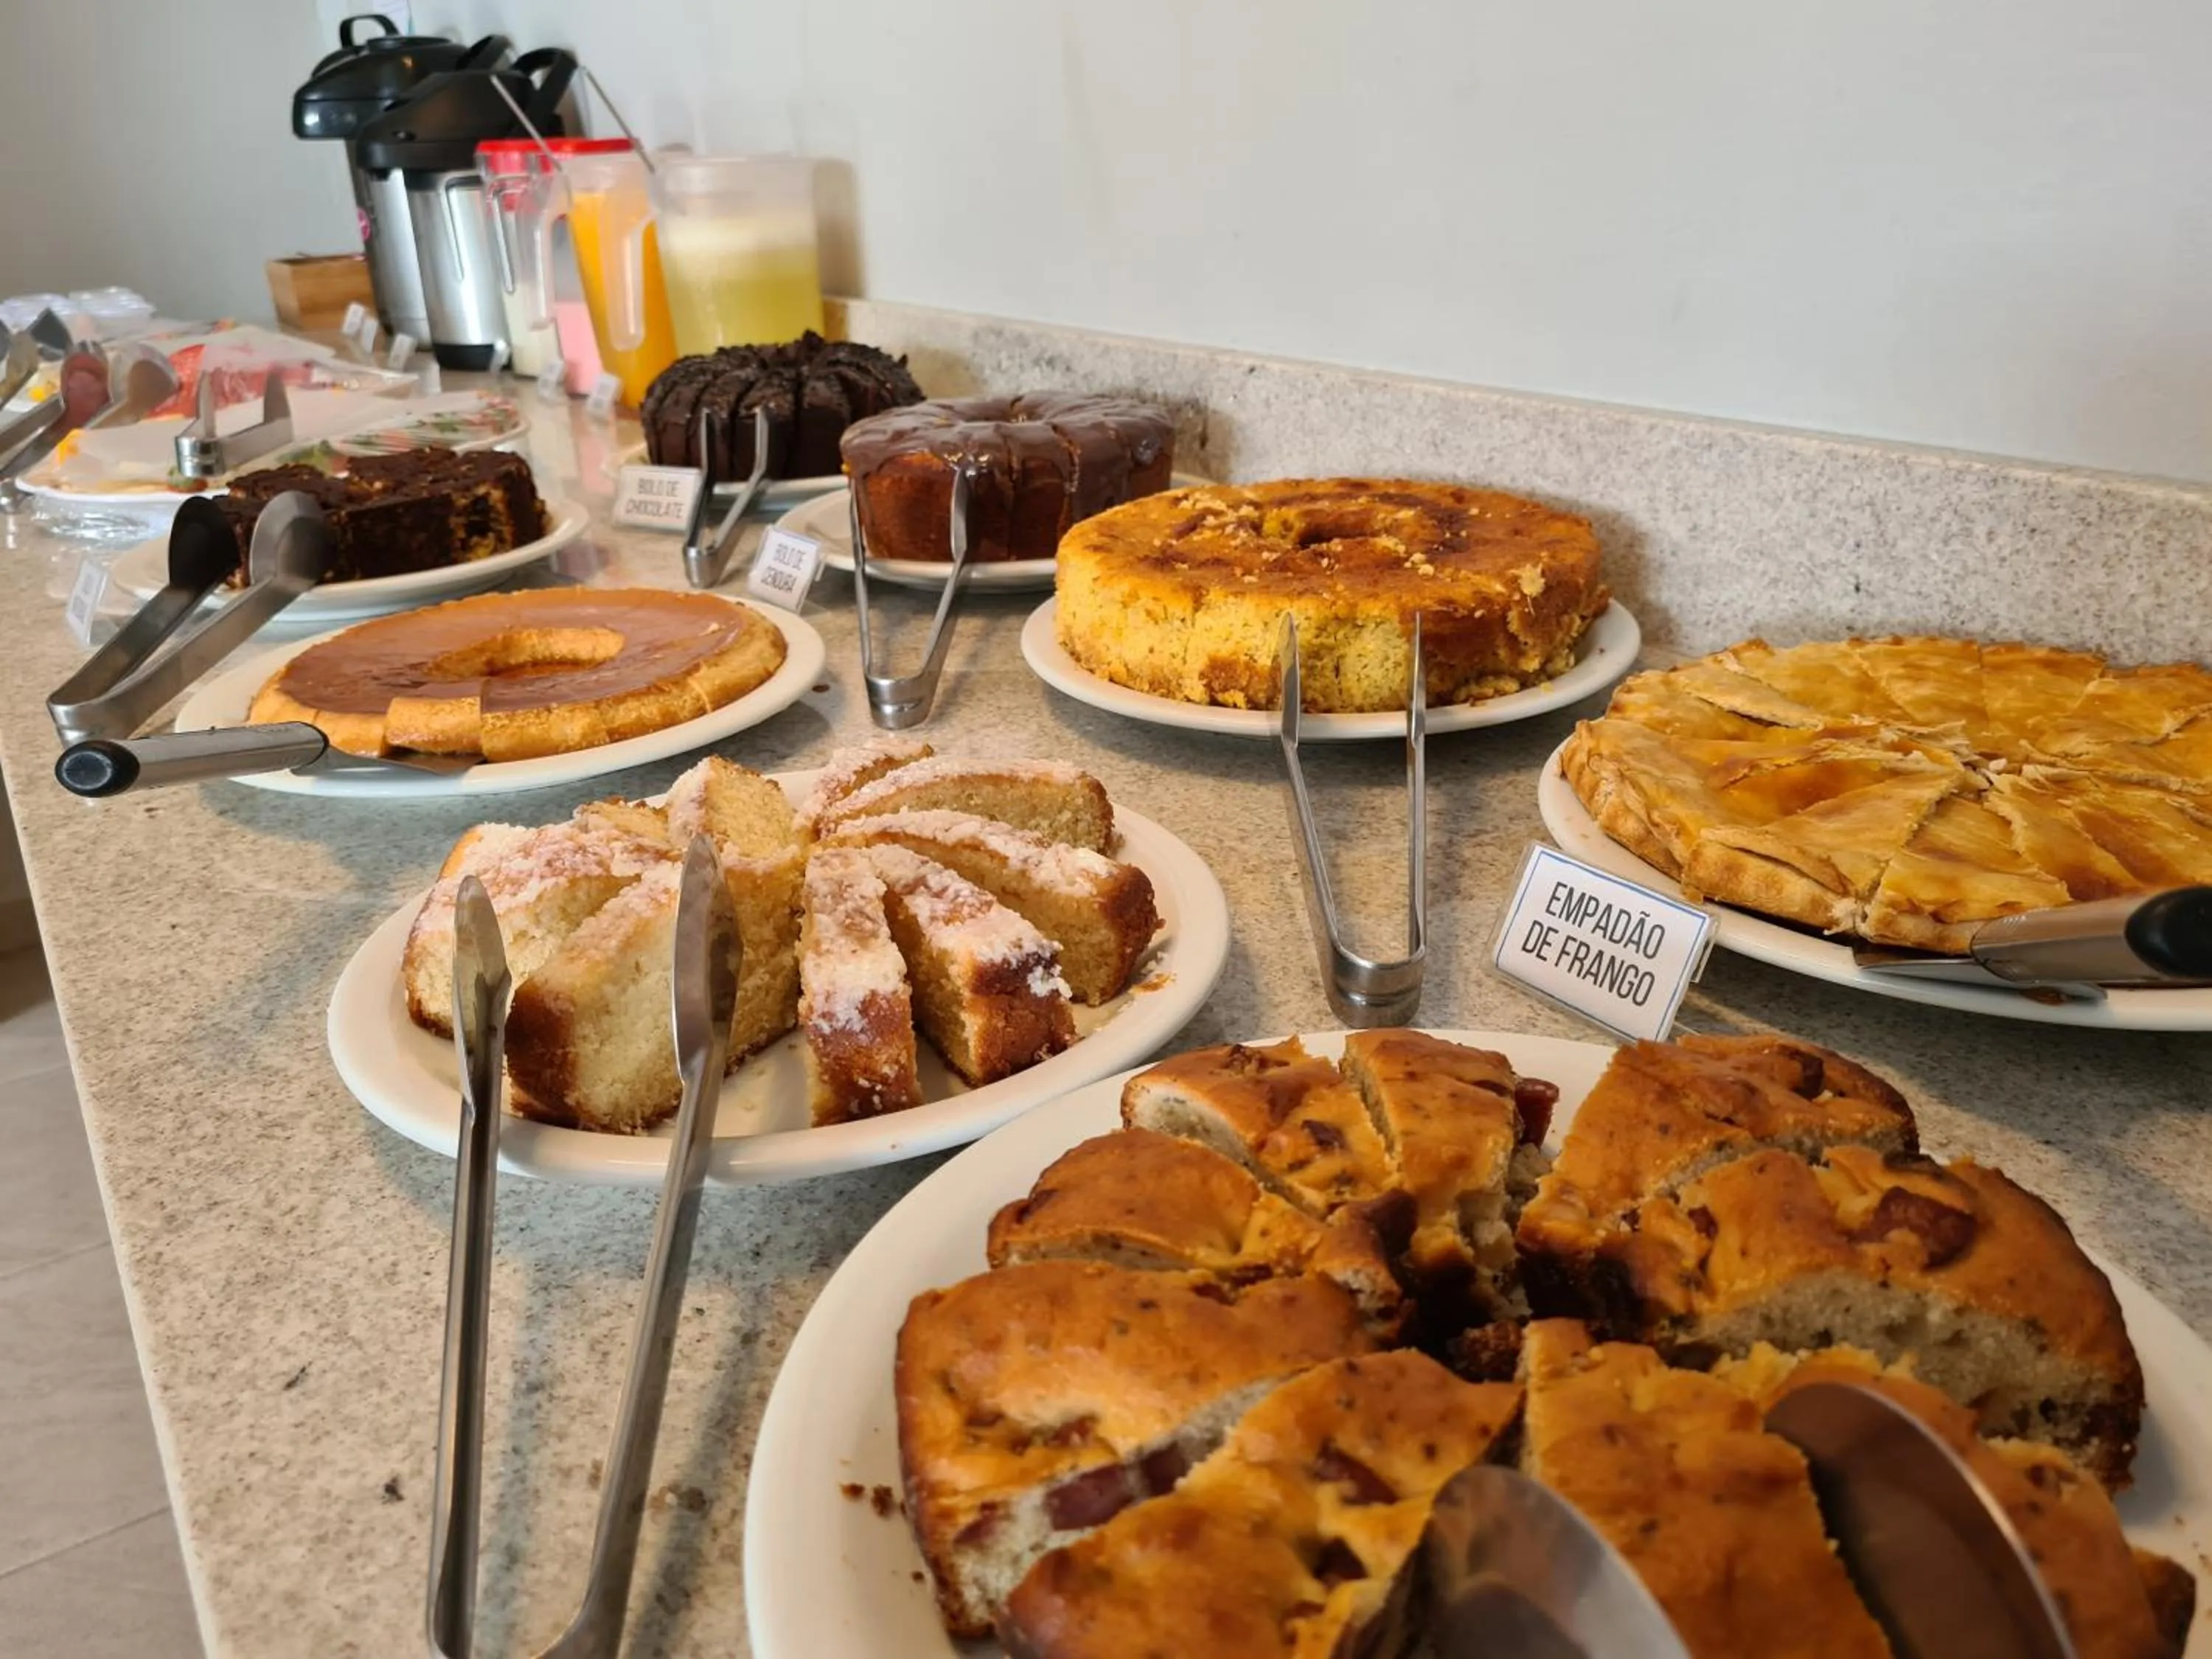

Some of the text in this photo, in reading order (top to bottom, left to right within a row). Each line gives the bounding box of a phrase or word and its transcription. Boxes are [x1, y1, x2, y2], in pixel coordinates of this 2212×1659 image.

[1545, 881, 1666, 959] EMPADÃO
[1521, 919, 1655, 1007] DE FRANGO
